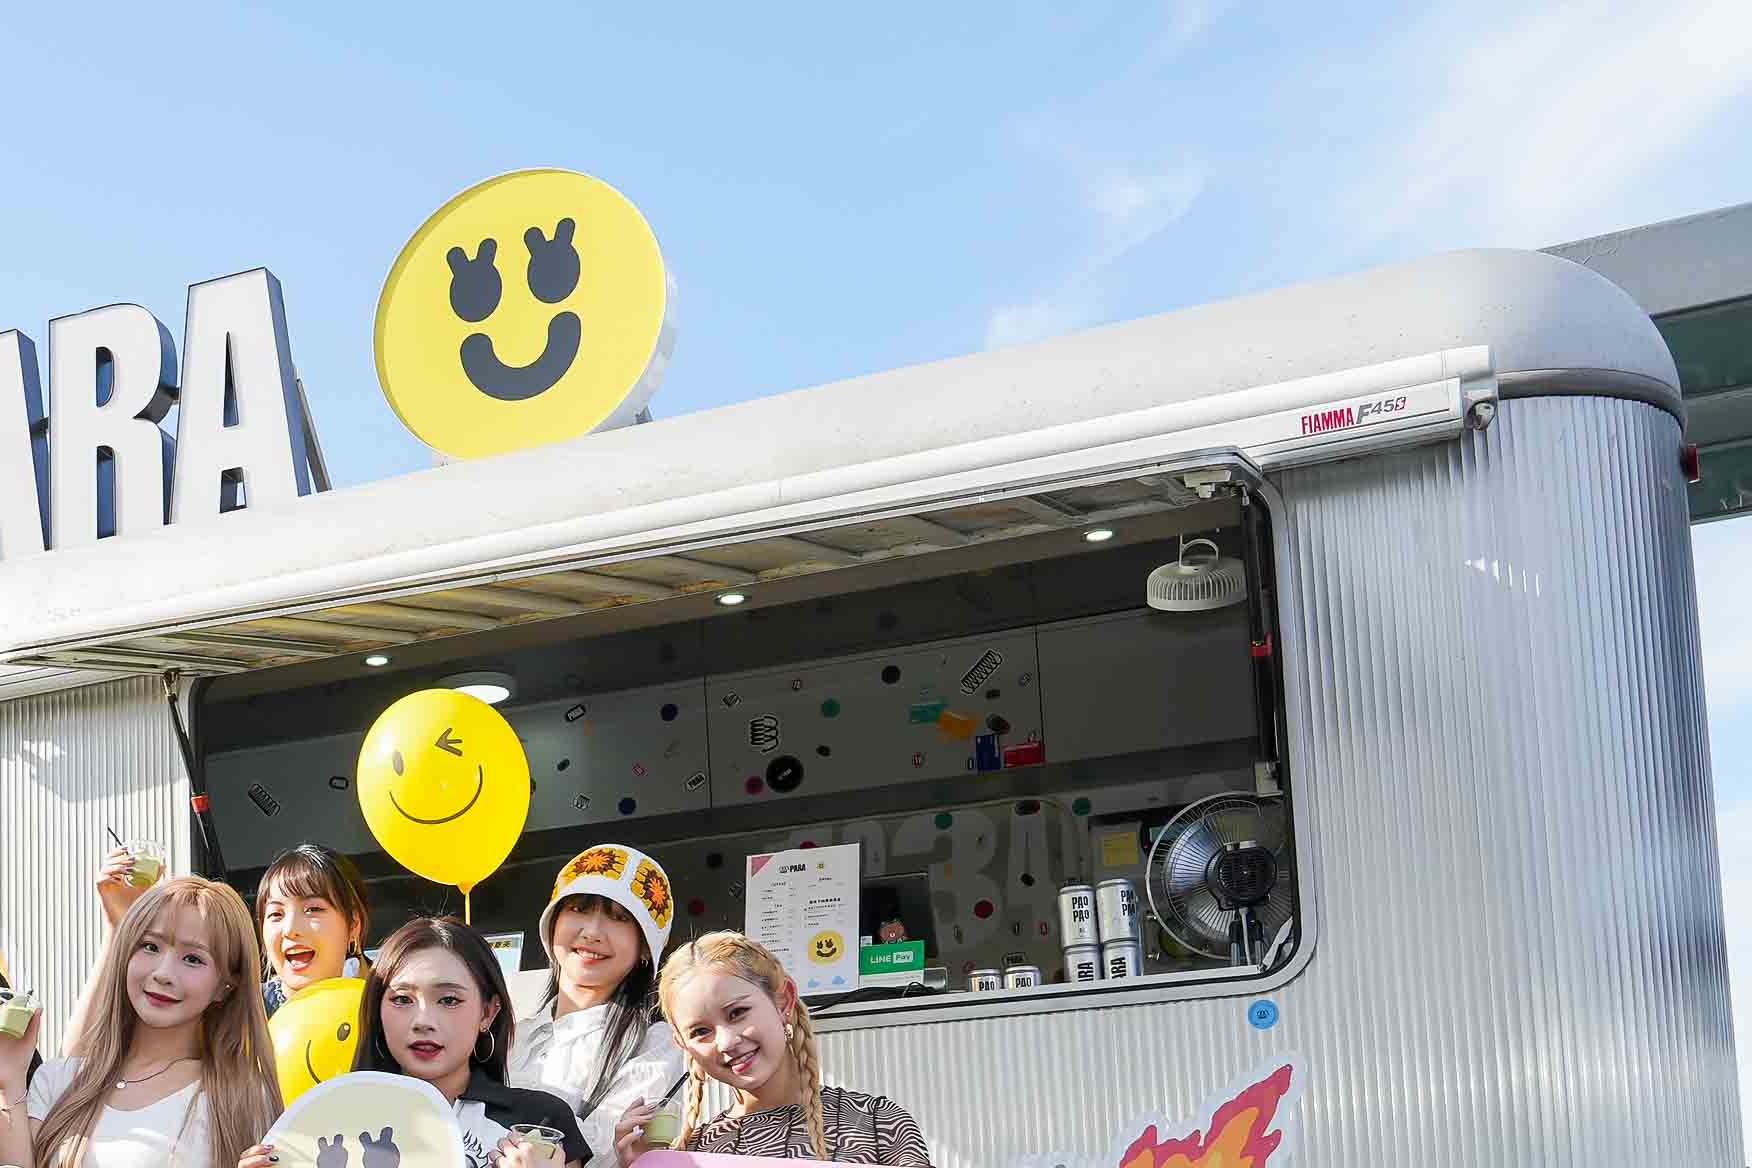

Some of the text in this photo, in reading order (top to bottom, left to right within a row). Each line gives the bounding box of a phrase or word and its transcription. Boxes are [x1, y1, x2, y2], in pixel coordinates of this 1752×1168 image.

[1301, 408, 1354, 434] FIAMMA
[789, 863, 806, 873] PARA
[1071, 896, 1089, 910] PAO
[1072, 910, 1090, 923] PAO
[870, 954, 892, 964] LINE
[1015, 977, 1032, 988] PAO
